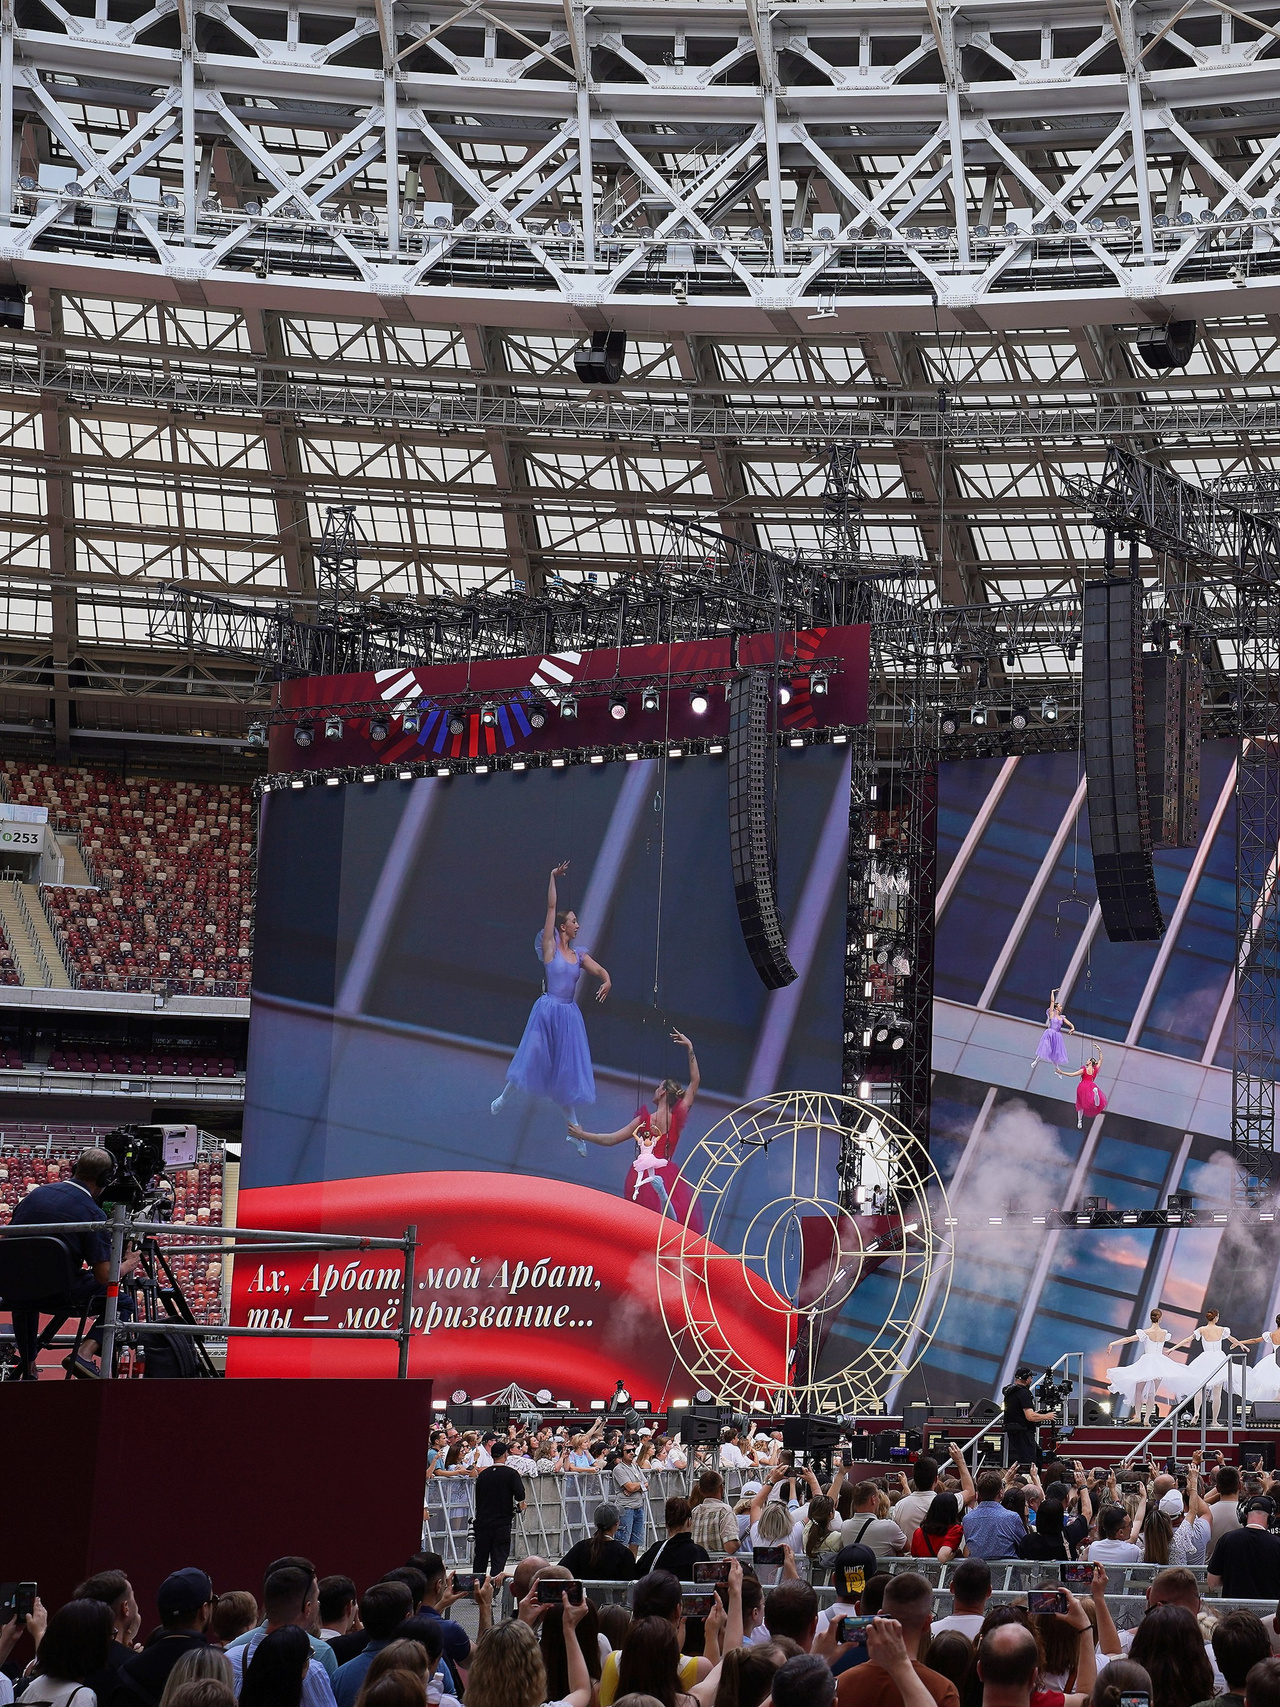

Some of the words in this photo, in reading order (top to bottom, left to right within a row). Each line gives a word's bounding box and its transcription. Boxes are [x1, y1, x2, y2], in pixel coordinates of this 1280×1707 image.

[13, 832, 39, 844] 253
[248, 1264, 290, 1296] Ах,
[418, 1256, 482, 1289] мой
[488, 1257, 601, 1295] Арбат,
[247, 1308, 293, 1329] ты
[338, 1298, 400, 1330] моё
[844, 1564, 865, 1573] UNITY
